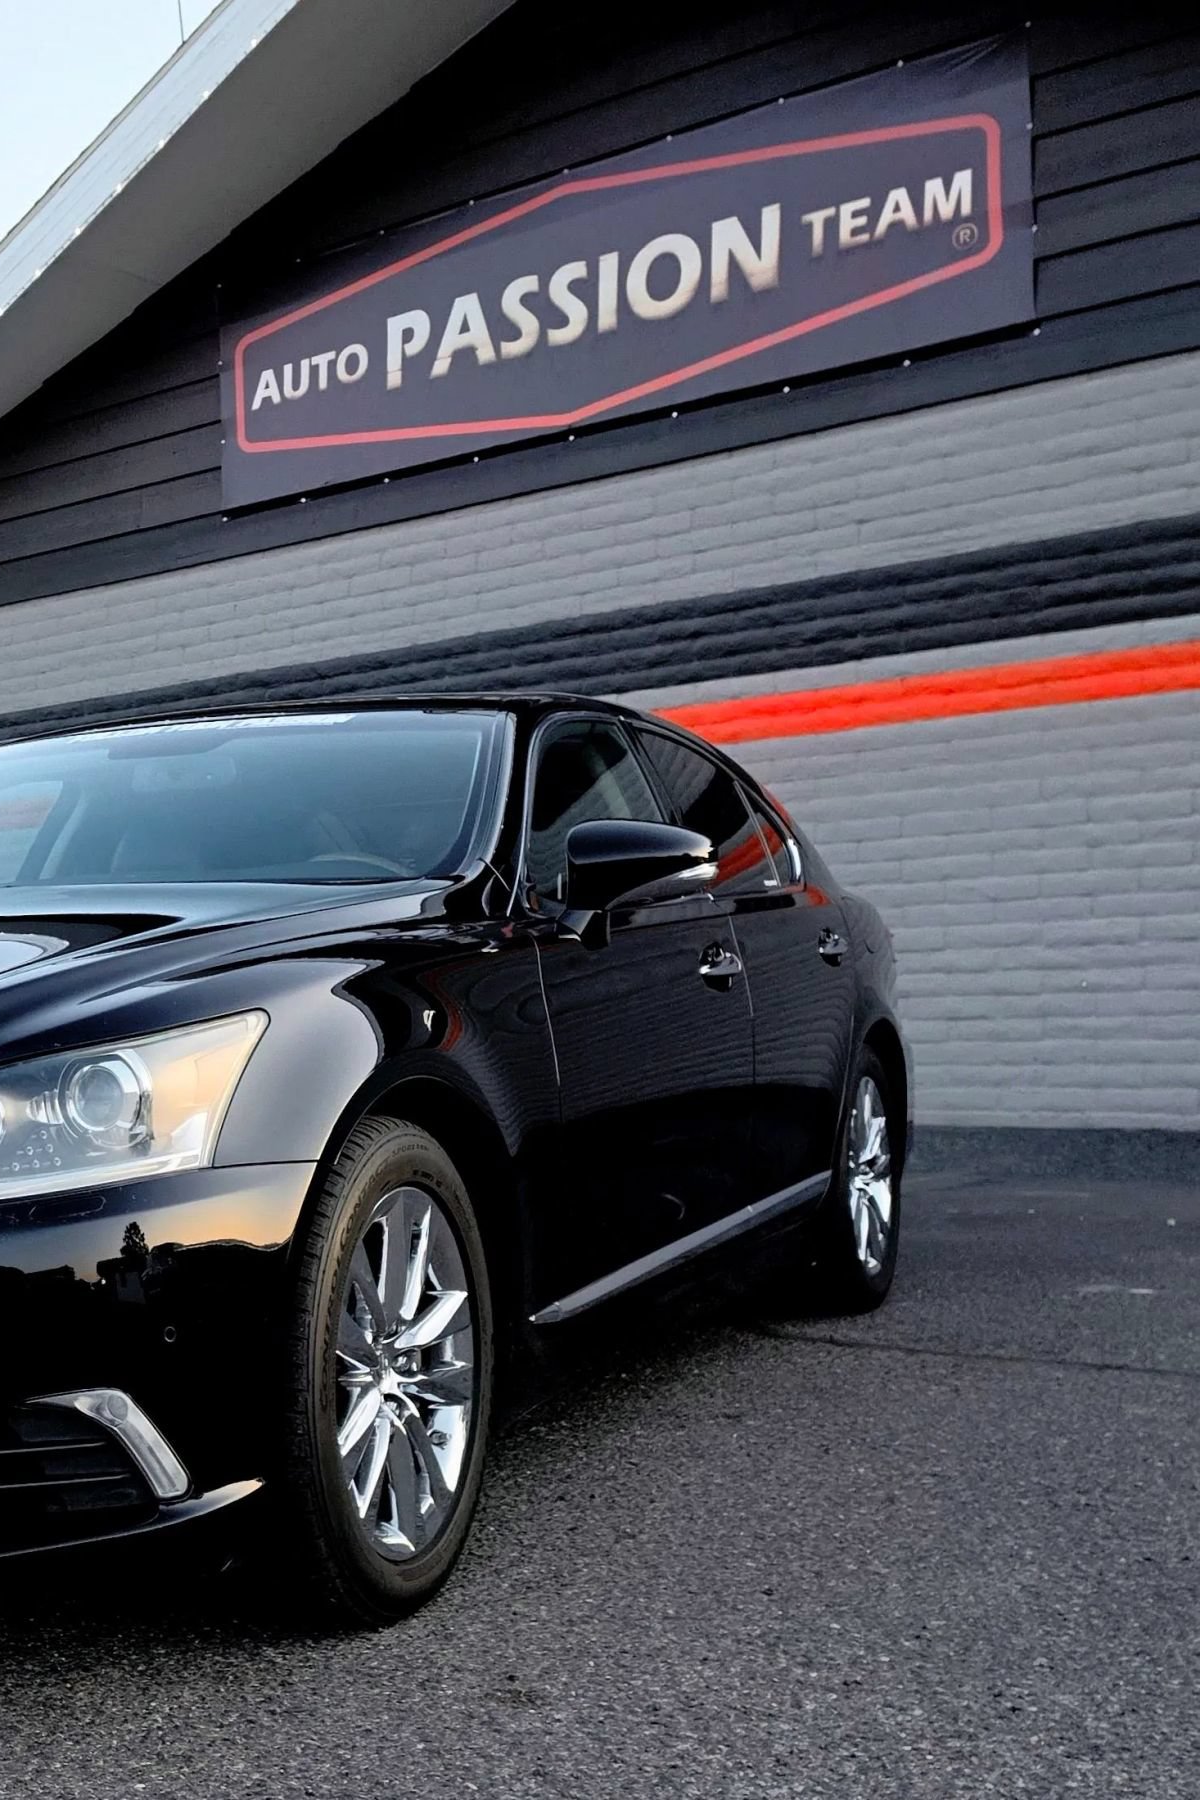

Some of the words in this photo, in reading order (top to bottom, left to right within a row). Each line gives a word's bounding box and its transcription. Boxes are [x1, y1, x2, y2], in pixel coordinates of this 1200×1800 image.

[252, 343, 368, 411] AUTO
[387, 204, 781, 390] PASSION
[803, 169, 973, 257] TEAM
